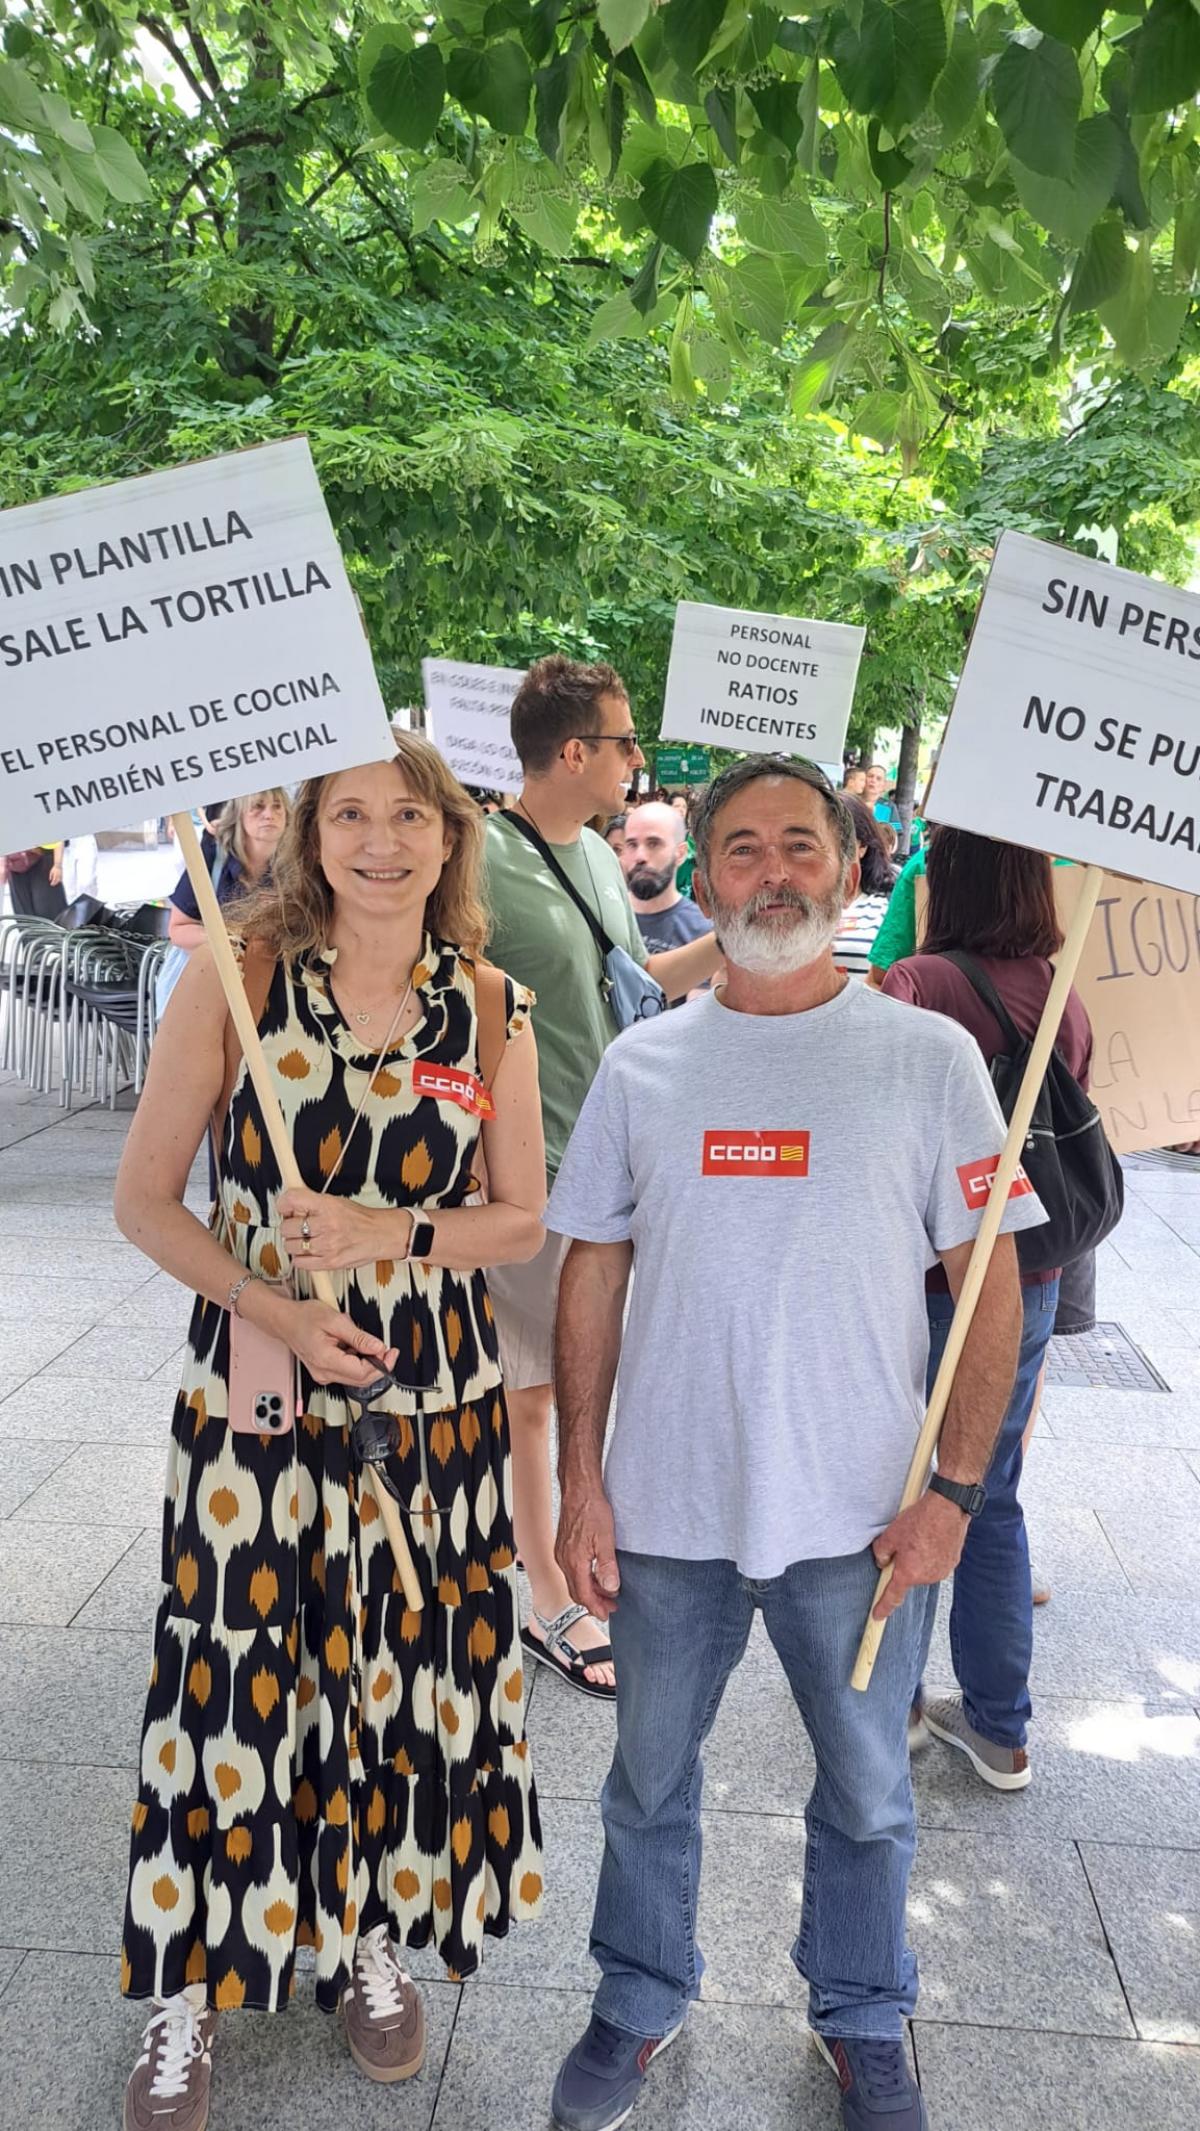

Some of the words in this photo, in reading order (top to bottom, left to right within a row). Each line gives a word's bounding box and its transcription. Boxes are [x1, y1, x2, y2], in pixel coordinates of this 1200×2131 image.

[50, 510, 253, 585] PLANTILLA
[0, 618, 91, 666] SALE
[97, 605, 148, 642] LA
[150, 561, 331, 628] TORTILLA
[1042, 579, 1109, 628] SIN
[730, 624, 812, 649] PERSONAL
[717, 650, 742, 665] NO
[746, 654, 819, 677] DOCENTE
[728, 680, 798, 706] RATIOS
[1, 748, 34, 774] EL
[37, 711, 185, 765] PERSONAL
[189, 699, 228, 728] DE
[233, 673, 340, 716] COCINA
[700, 708, 817, 740] INDECENTES
[1023, 696, 1086, 741] NO
[1094, 718, 1142, 759] SE
[1149, 734, 1200, 781] PU
[34, 763, 165, 813] TAMBIÉN
[170, 755, 204, 782] ES
[208, 723, 337, 774] ESENCIAL
[1036, 772, 1200, 854] TRABAJA
[420, 1075, 475, 1102] CCOO
[709, 1145, 776, 1161] CCOO
